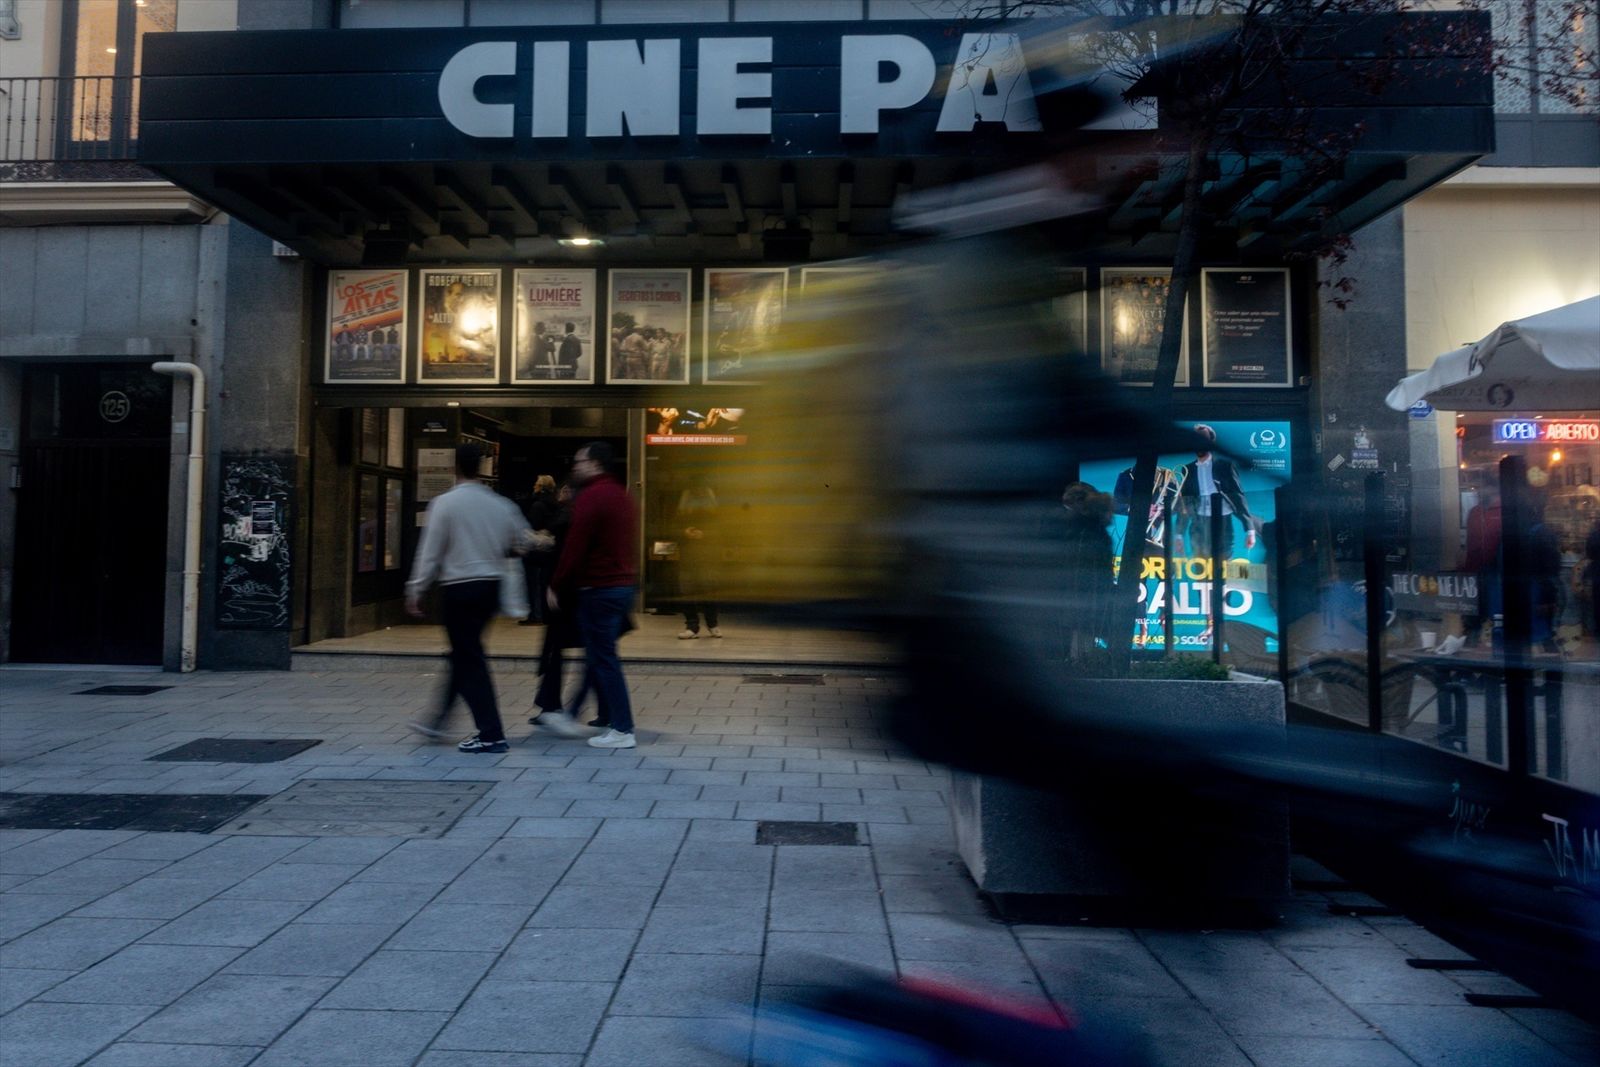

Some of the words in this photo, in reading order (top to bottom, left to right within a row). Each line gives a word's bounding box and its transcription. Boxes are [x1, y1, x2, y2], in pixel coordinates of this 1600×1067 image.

[438, 37, 773, 138] CINE
[335, 282, 365, 300] LOS
[529, 286, 582, 302] LUMIÈRE
[103, 399, 126, 415] 125
[1502, 422, 1537, 439] OPEN
[1546, 423, 1599, 440] ABIERTO
[1391, 574, 1410, 594] THE
[1455, 576, 1479, 598] LAB
